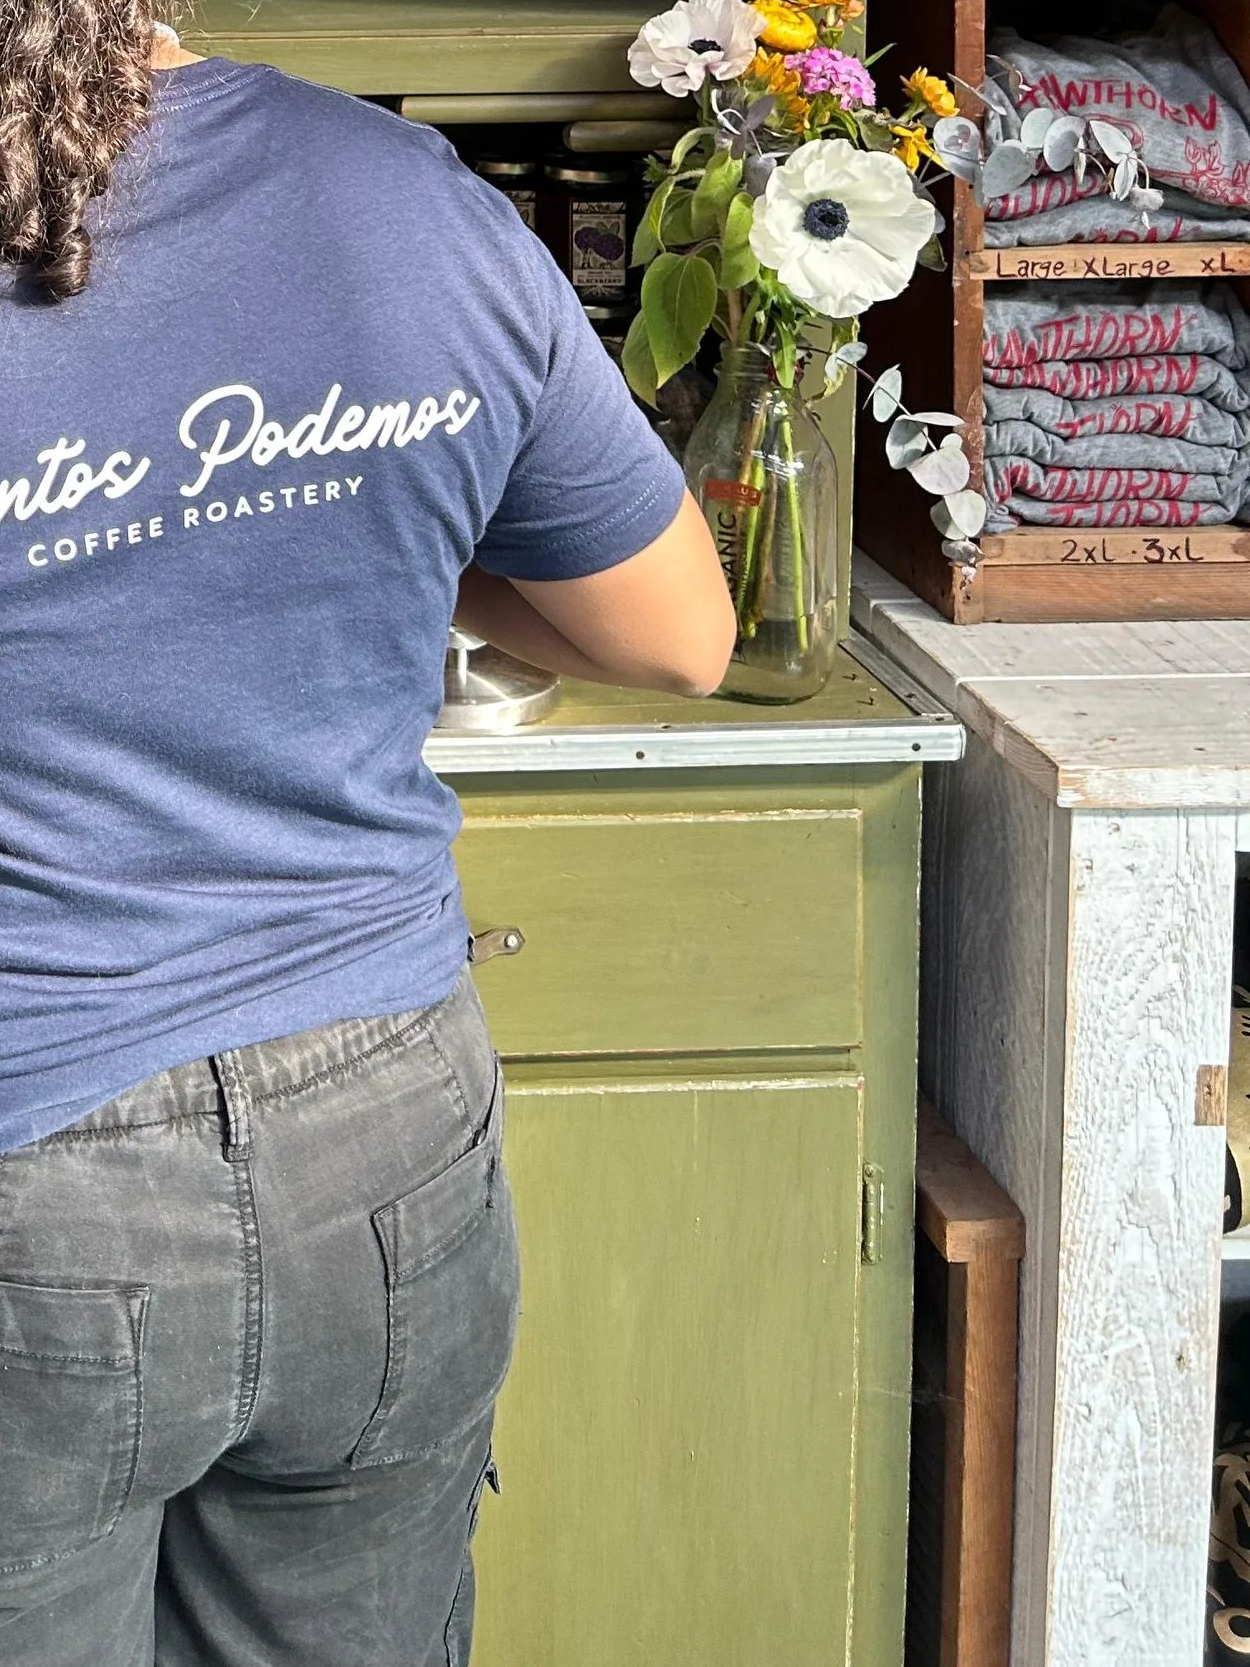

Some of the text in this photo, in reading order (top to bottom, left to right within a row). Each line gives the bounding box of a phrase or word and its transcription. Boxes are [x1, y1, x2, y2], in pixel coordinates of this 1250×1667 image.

[996, 251, 1066, 279] Large
[179, 382, 481, 498] Podemos
[27, 475, 365, 568] COFFEE ROASTERY
